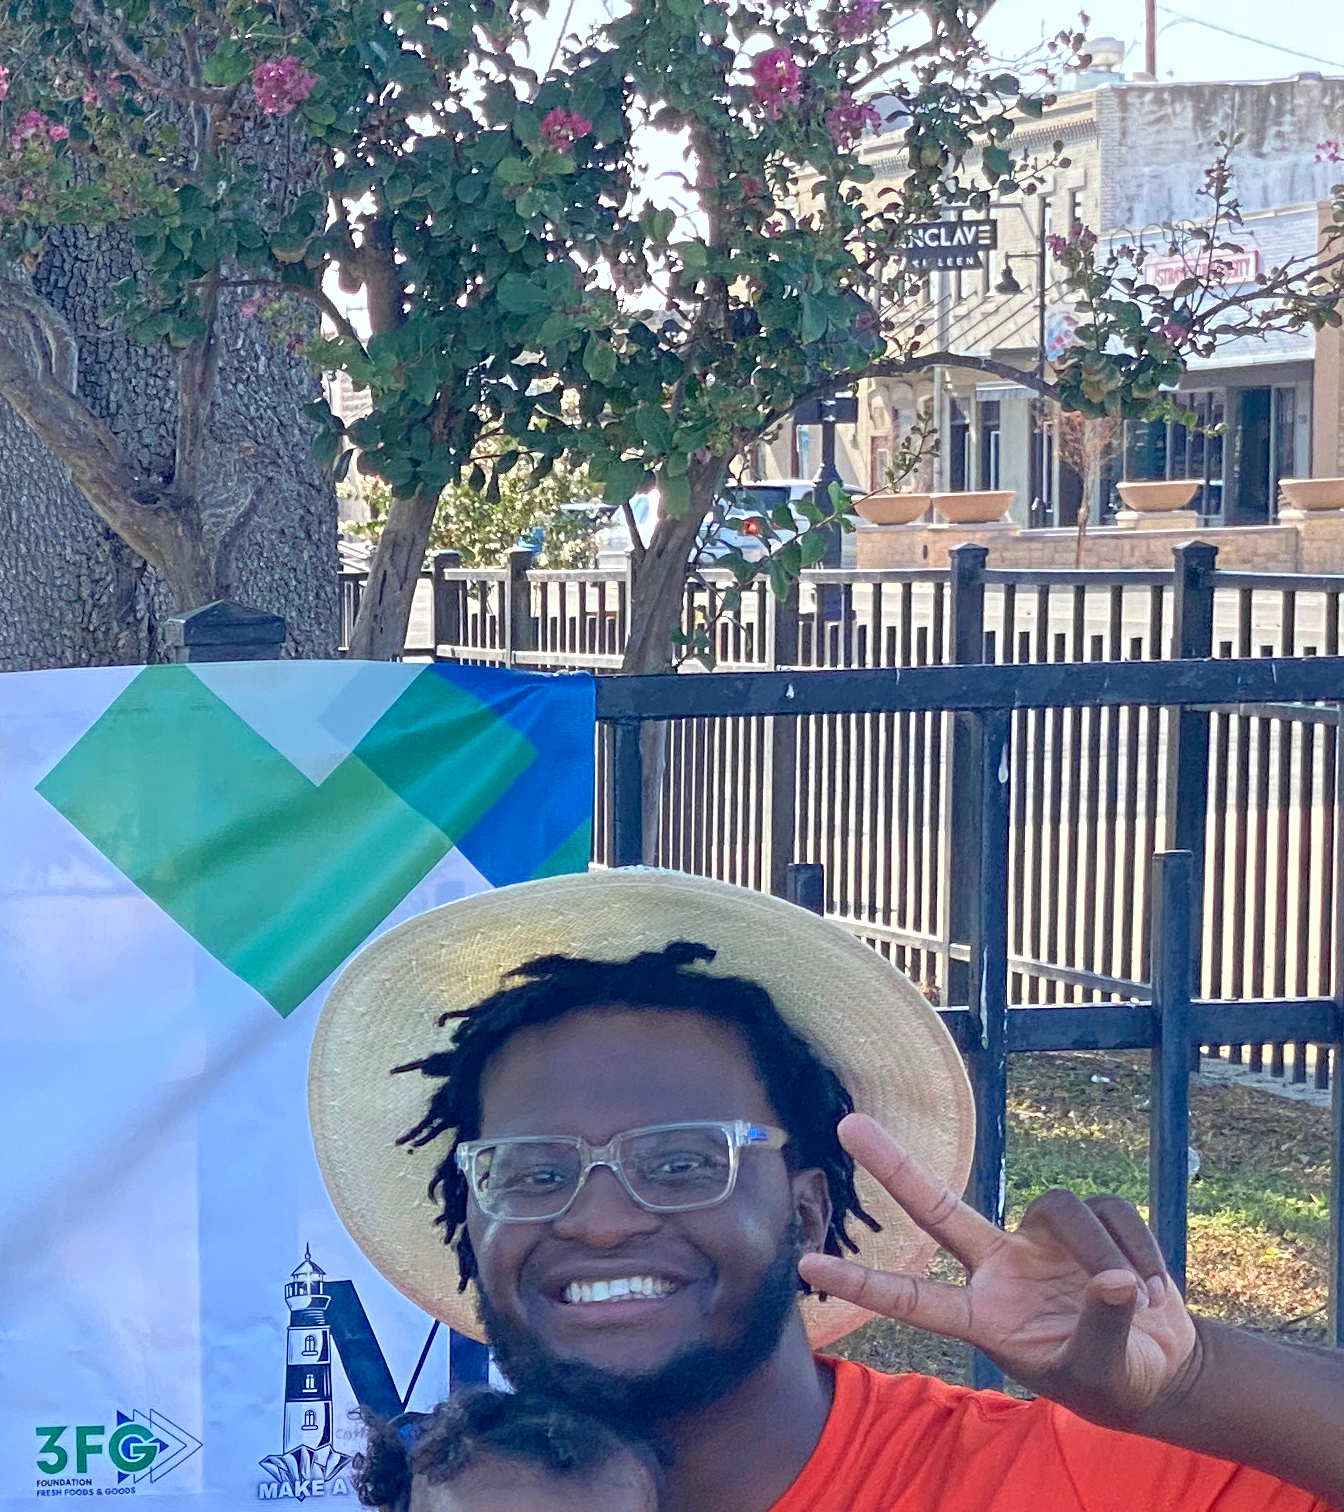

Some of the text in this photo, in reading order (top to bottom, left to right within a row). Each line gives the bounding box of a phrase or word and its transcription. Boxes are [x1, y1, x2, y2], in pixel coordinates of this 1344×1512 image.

[902, 226, 991, 249] NCLAVE
[35, 1422, 162, 1477] 3FG
[36, 1478, 93, 1488] FOUNDATION
[36, 1486, 137, 1498] FRESH FOODS & GOODS
[258, 1478, 349, 1500] MAKE A
